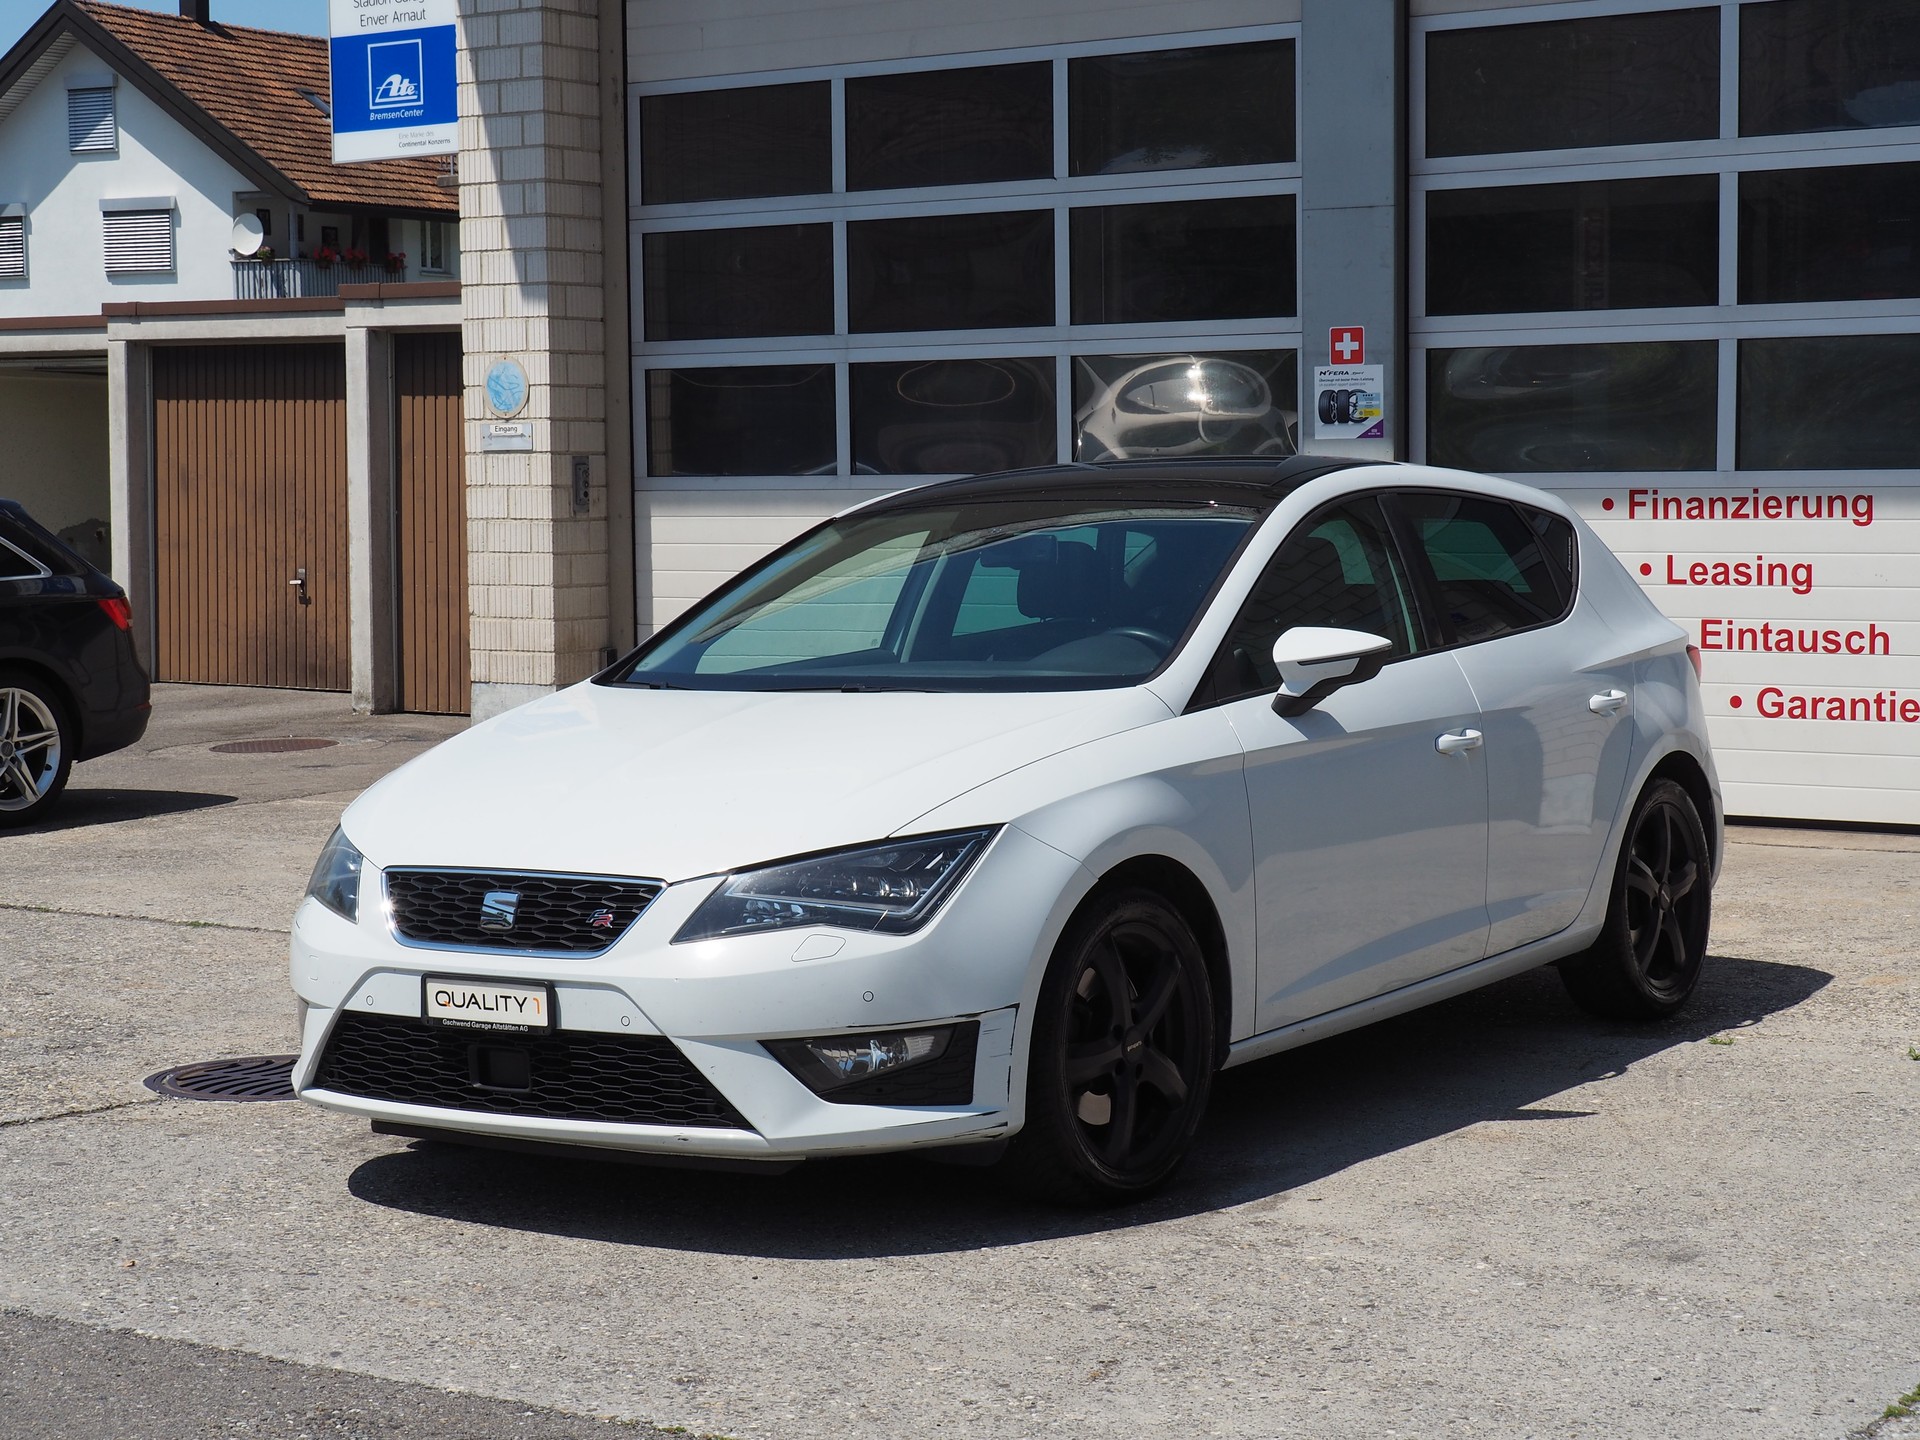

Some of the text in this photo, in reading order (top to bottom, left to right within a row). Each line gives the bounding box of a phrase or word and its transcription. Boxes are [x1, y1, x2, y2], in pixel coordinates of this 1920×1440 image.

[360, 8, 426, 27] Enver Arnaut
[375, 74, 418, 103] Ate
[369, 109, 424, 121] BremsenCenter
[398, 139, 427, 148] Continental
[494, 425, 518, 434] Eingang
[1628, 489, 1874, 526] Finanzierung
[1667, 555, 1813, 594] Leasing
[1701, 619, 1890, 655] Eintausch
[1757, 687, 1920, 722] Garantie
[442, 1018, 471, 1027] Gschwend
[471, 1021, 492, 1030] Garage
